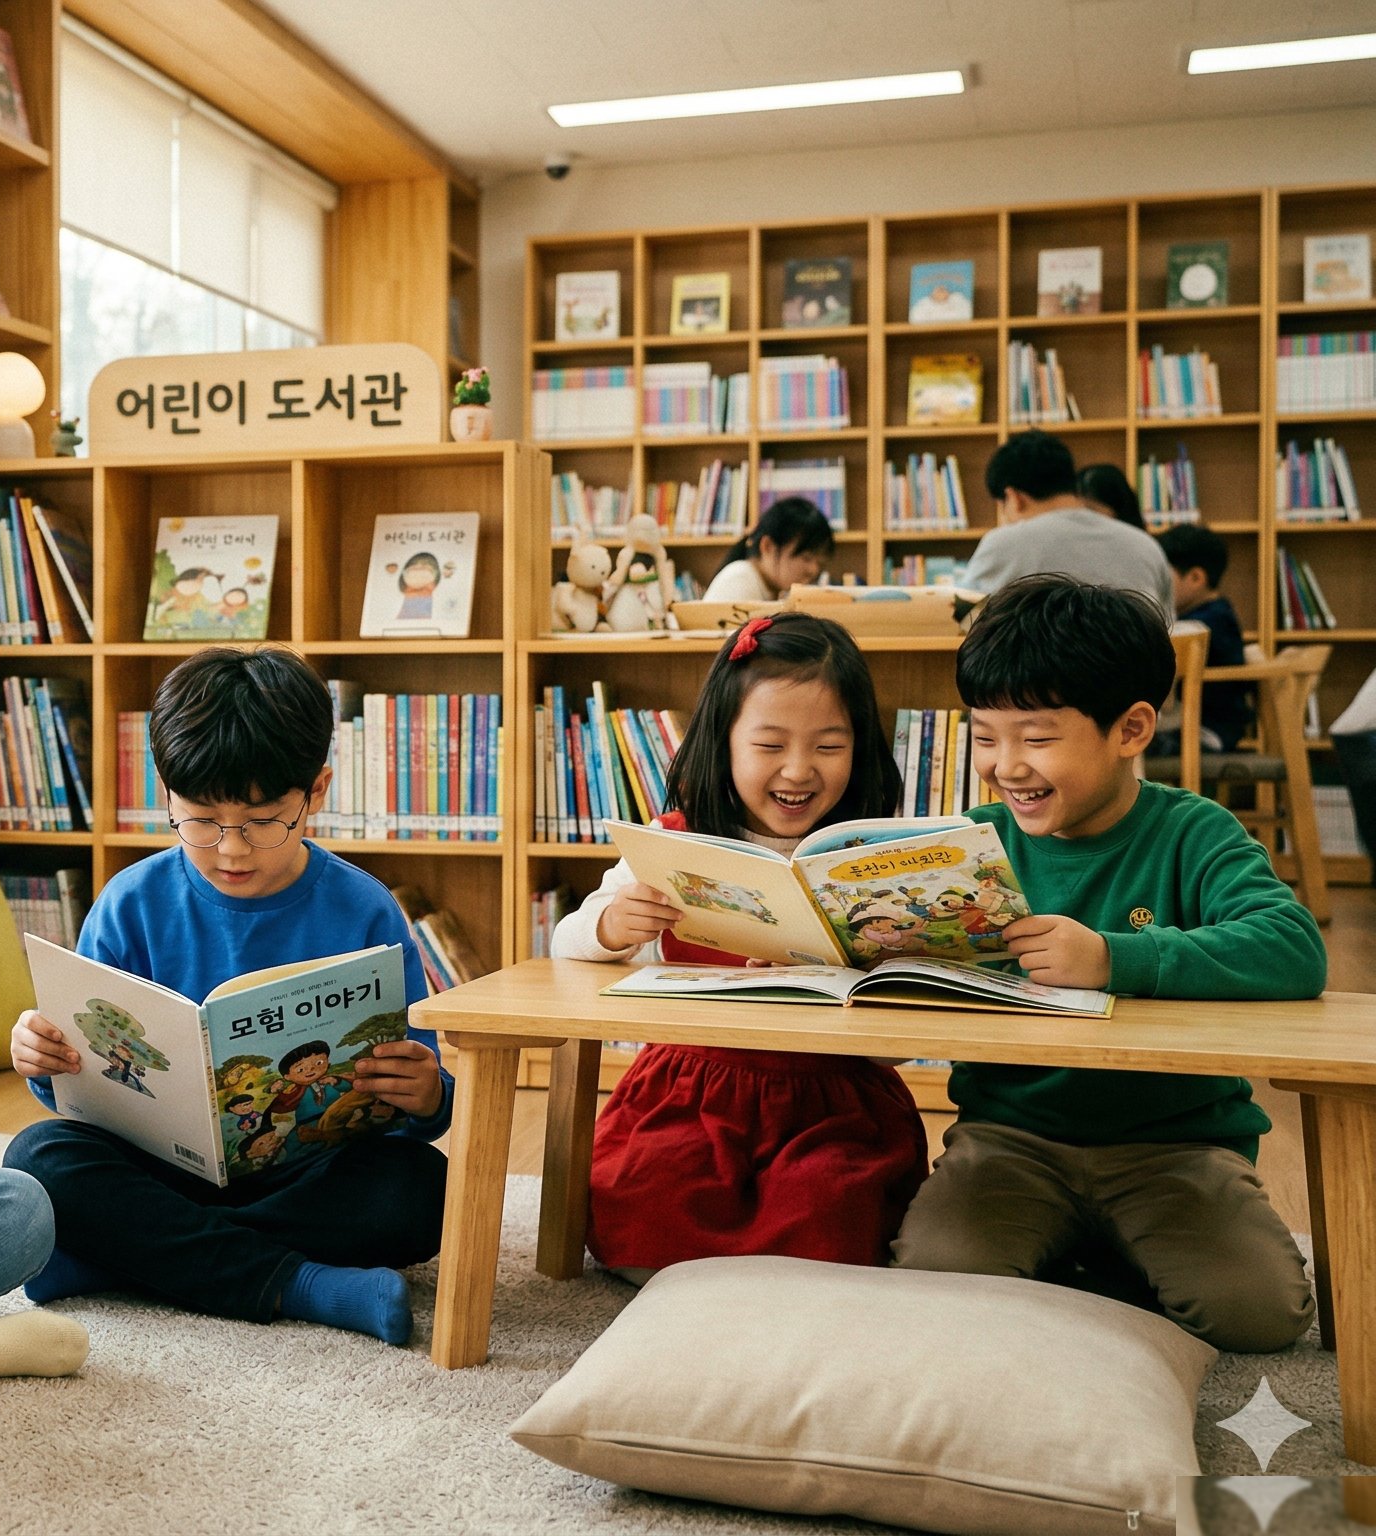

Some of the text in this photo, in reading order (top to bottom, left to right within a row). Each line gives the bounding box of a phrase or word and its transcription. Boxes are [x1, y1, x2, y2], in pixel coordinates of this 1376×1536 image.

[116, 371, 409, 435] 어린이 도서관
[384, 529, 466, 545] 어린이 도서관
[229, 1005, 286, 1041] 모험
[295, 977, 381, 1018] 이야기
